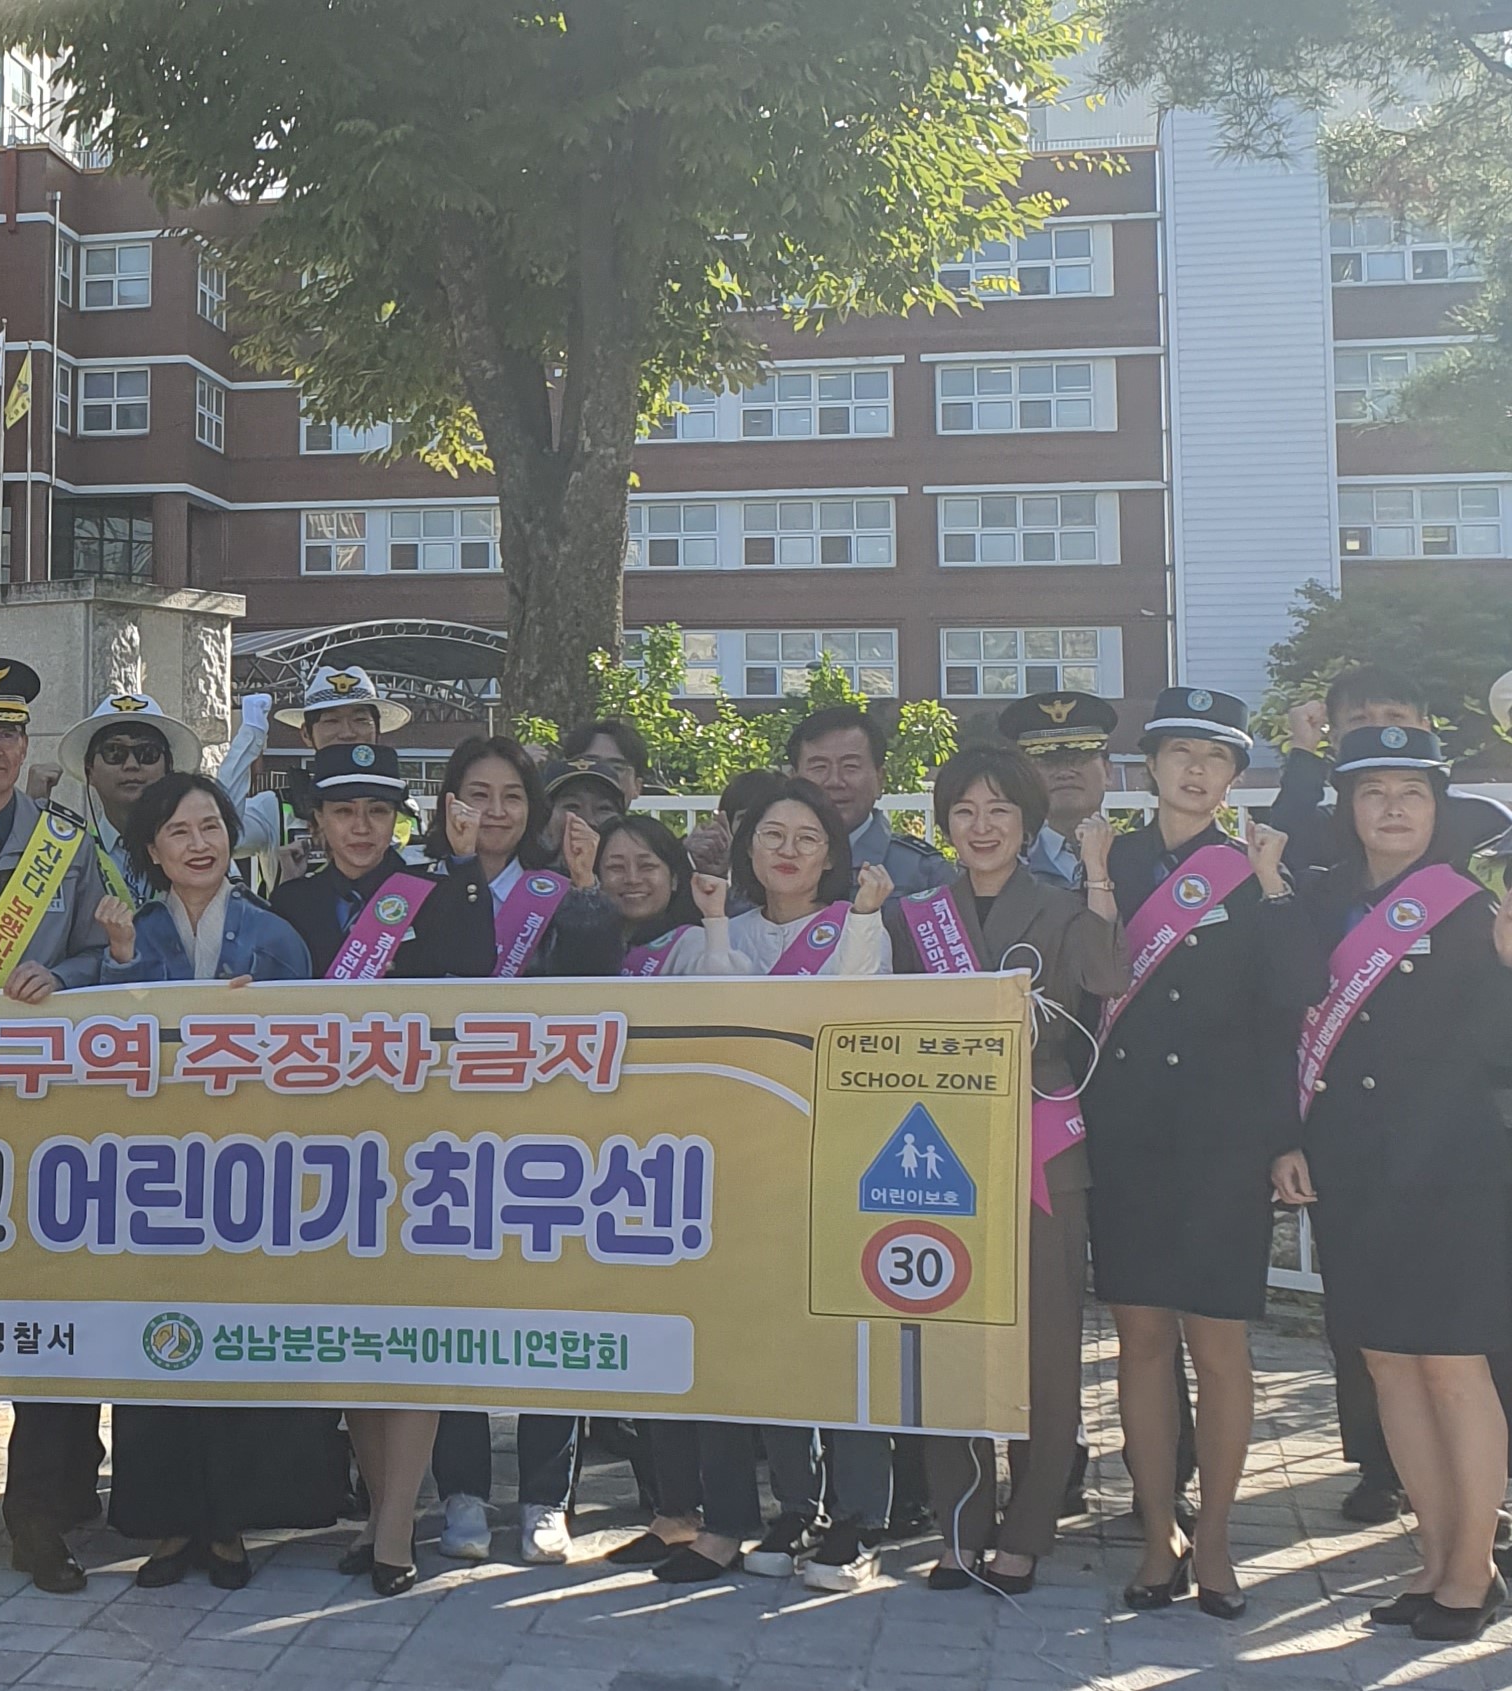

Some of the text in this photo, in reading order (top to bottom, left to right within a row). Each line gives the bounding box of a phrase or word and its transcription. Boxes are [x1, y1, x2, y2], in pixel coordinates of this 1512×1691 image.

[22, 839, 63, 898] 차보다
[182, 1021, 432, 1091] 주정차
[454, 1018, 620, 1087] 금지
[835, 1034, 1006, 1057] 어린이 보호구역
[840, 1070, 998, 1092] SCHOOL ZONE
[37, 1140, 387, 1250] 어린이가
[410, 1138, 705, 1257] 최우선!
[870, 1186, 961, 1208] 어린이보호
[889, 1246, 943, 1288] 30
[212, 1323, 630, 1374] 성남분당녹색어머니연합회
